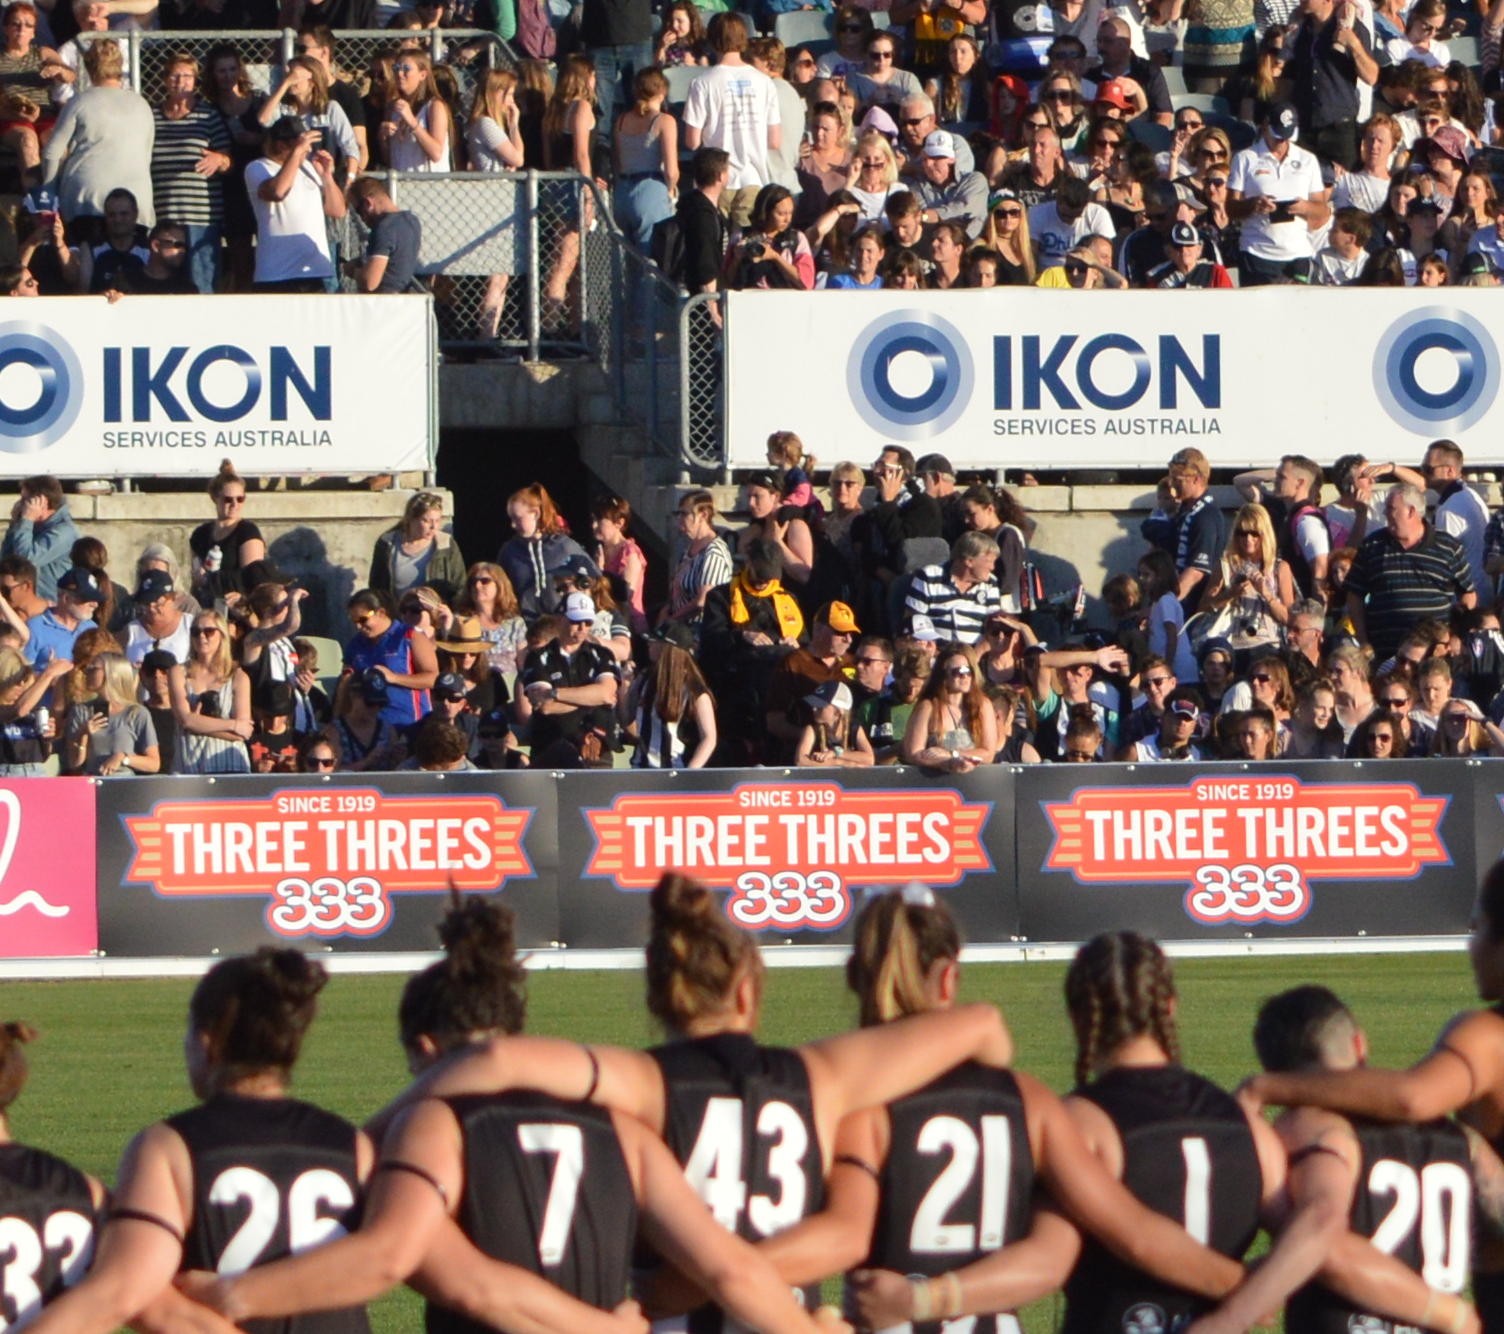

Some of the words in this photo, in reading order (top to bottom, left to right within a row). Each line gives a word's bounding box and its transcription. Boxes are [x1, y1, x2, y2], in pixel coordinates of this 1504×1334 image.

[103, 344, 332, 423] IKON
[993, 333, 1222, 410] IKON
[103, 431, 207, 449] SERVICES
[214, 430, 332, 448] AUSTRALIA
[993, 418, 1096, 436] SERVICES
[1104, 417, 1222, 435] AUSTRALIA
[278, 797, 331, 813] SINCE
[337, 795, 375, 812] 1919
[740, 791, 792, 807] SINCE
[797, 790, 835, 806] 1919
[1197, 784, 1250, 801] SINCE
[1255, 783, 1294, 800] 1919
[165, 821, 310, 874] THREE
[319, 817, 492, 871] THREES
[626, 815, 770, 867] THREE
[779, 812, 950, 865] THREES
[1085, 808, 1229, 861] THREE
[1237, 805, 1409, 858] THREES
[272, 877, 385, 930] 333
[732, 870, 844, 924] 333
[1192, 863, 1304, 916] 333
[685, 1096, 809, 1236] 43
[910, 1114, 1011, 1254] 21
[1181, 1137, 1211, 1246] 1
[517, 1123, 584, 1266] 7
[1368, 1159, 1472, 1294] 20
